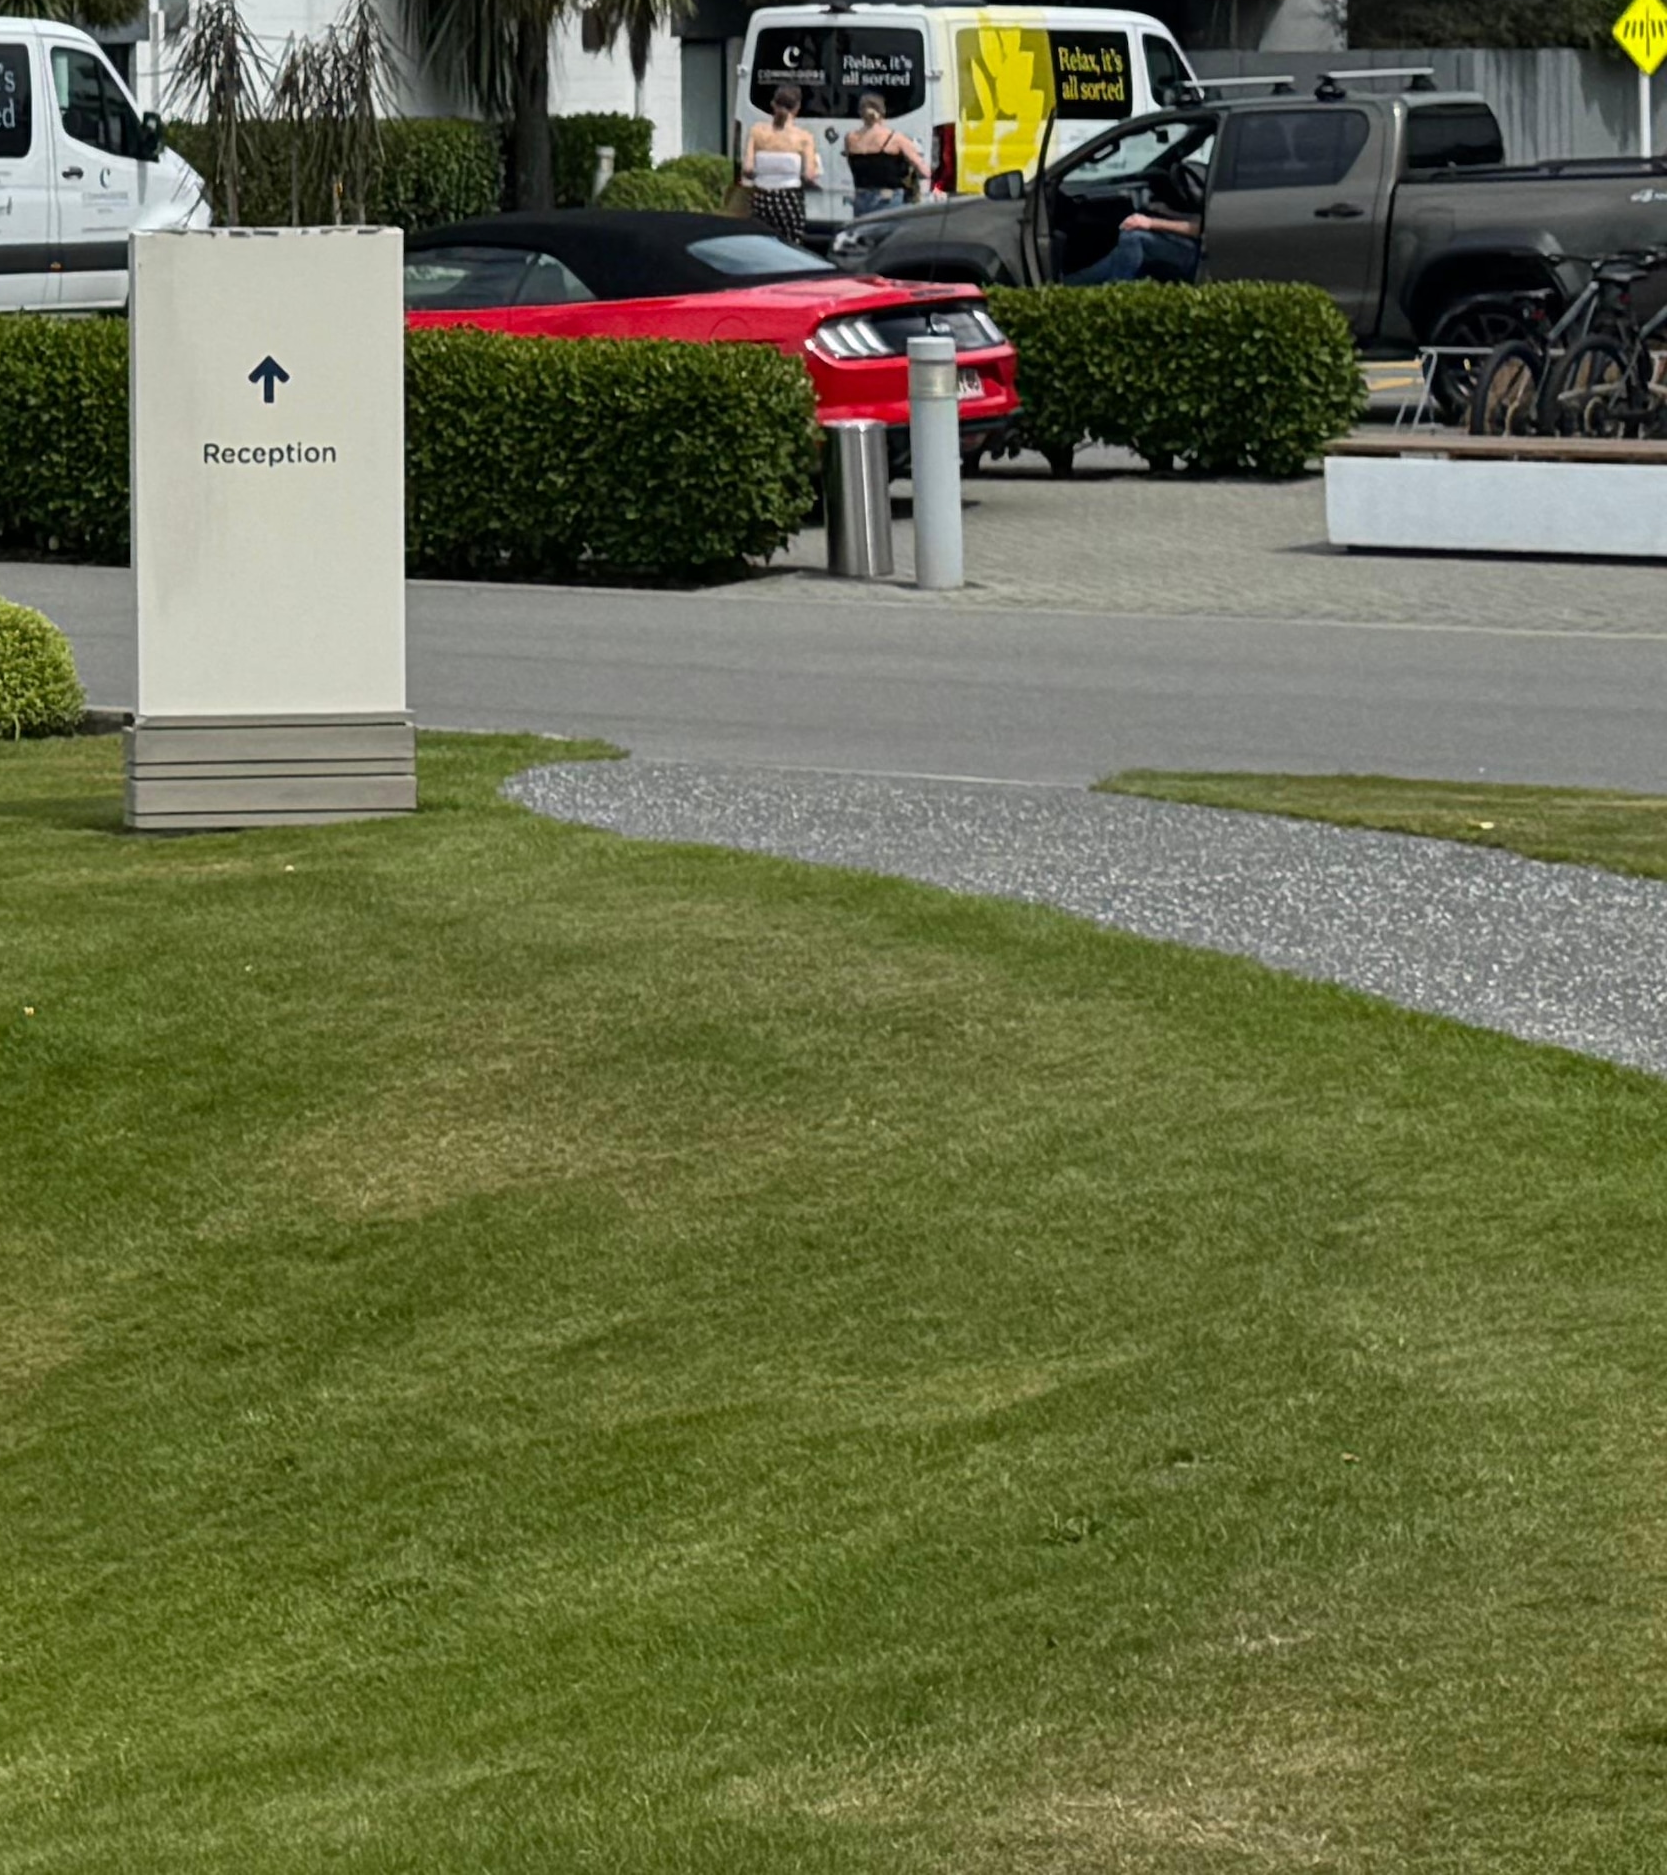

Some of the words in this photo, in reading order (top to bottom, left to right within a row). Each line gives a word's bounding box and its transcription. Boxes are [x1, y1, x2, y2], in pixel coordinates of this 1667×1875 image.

[1058, 46, 1101, 76] Relax,
[842, 72, 859, 86] all
[862, 72, 910, 87] sorted
[1062, 74, 1079, 100] all
[1080, 75, 1125, 101] sorted
[202, 441, 337, 468] Reception
